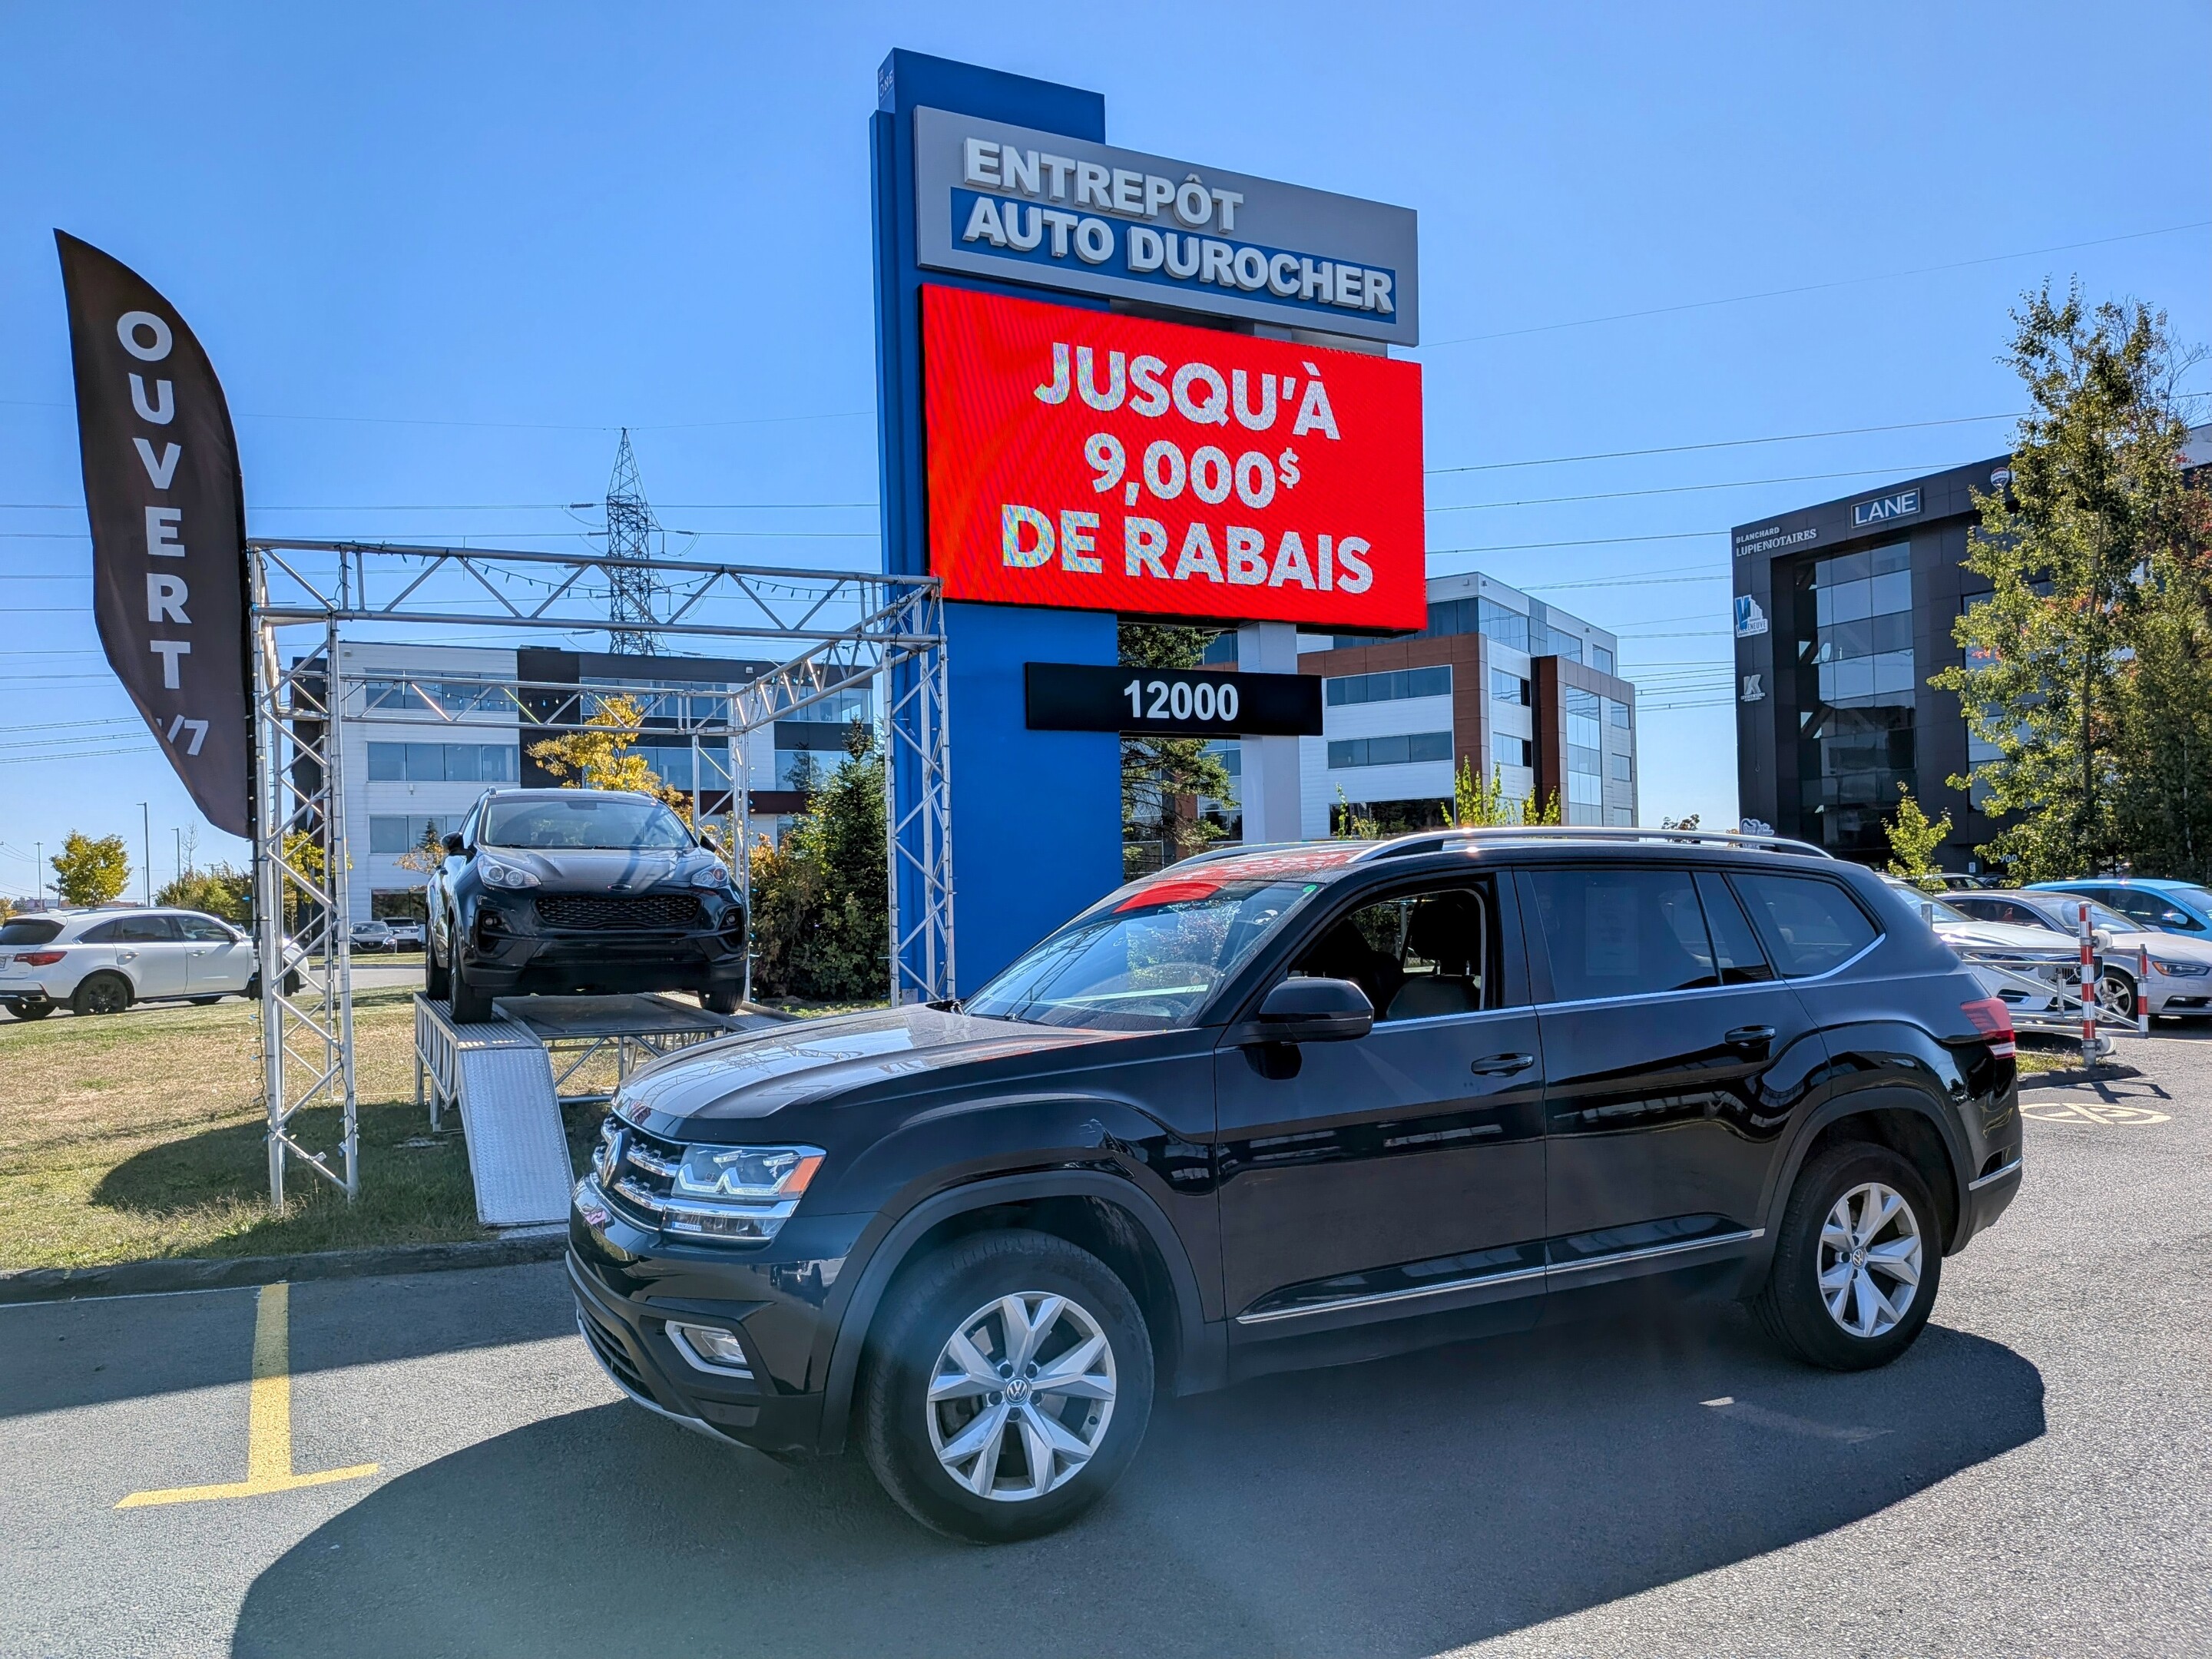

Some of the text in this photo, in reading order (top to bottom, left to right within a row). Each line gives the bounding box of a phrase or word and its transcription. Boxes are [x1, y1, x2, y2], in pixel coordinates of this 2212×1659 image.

[879, 69, 893, 97] ONE
[962, 137, 1243, 233] ENTREPÔT
[962, 196, 1394, 313] AUTO DUROCHER
[1034, 342, 1340, 440] JUSQU'À
[117, 311, 191, 689] OUVERT
[1736, 527, 1780, 544] BLANCHARD
[1856, 492, 1916, 524] LANE
[1002, 504, 1373, 594] DE RABAIS
[1124, 680, 1238, 720] 12000
